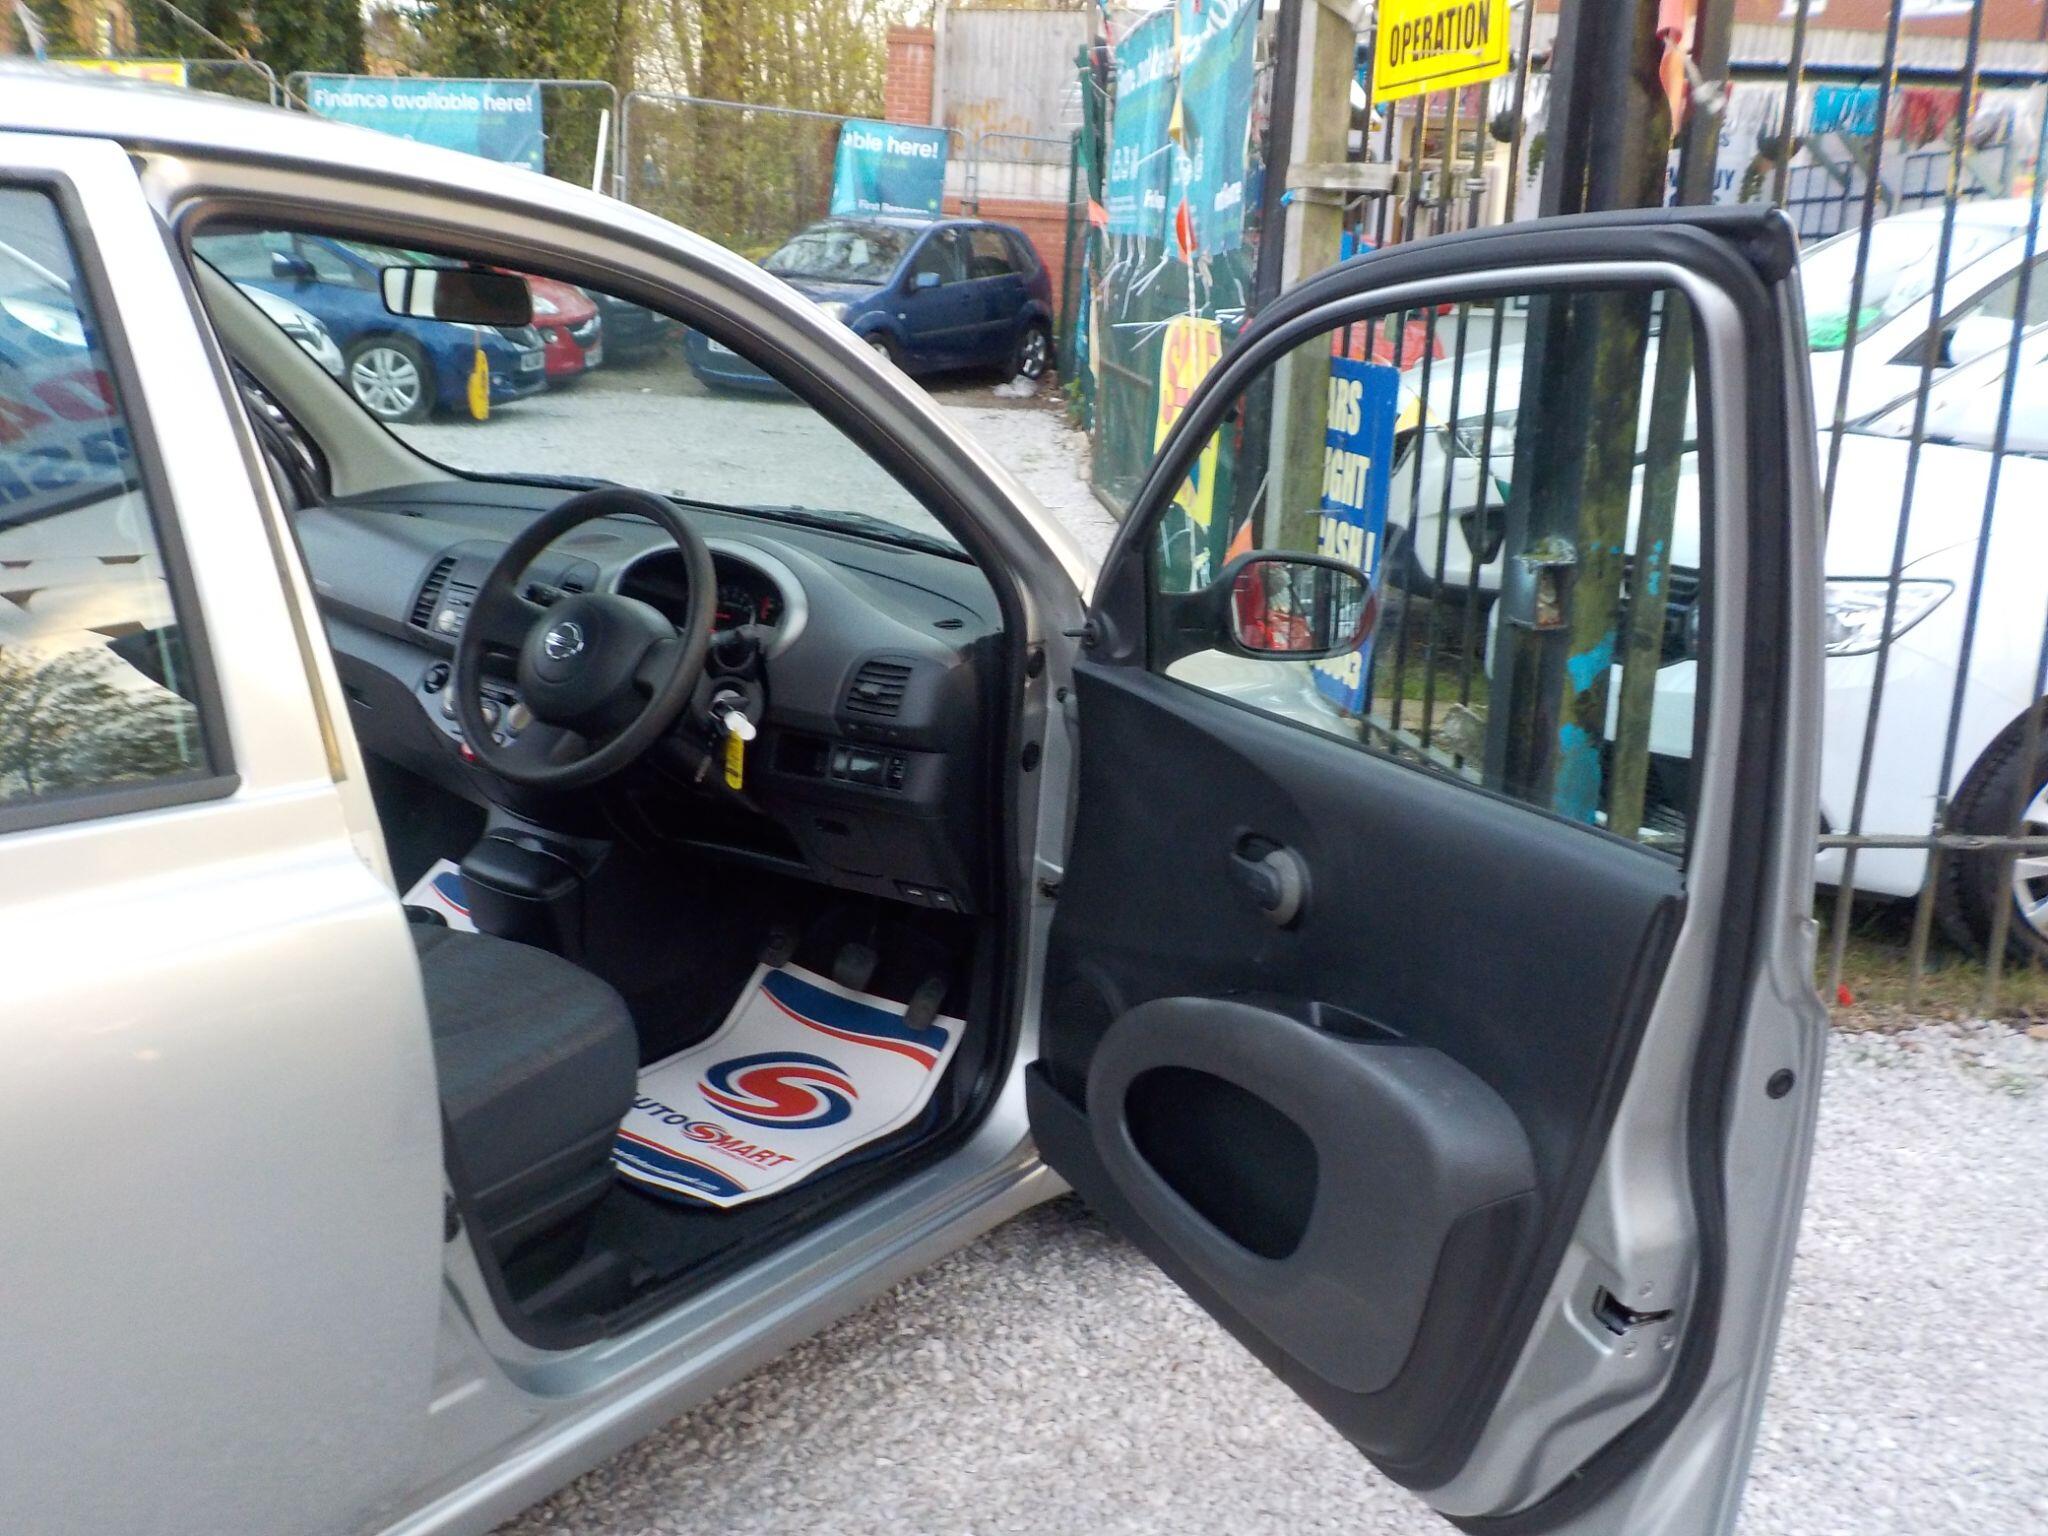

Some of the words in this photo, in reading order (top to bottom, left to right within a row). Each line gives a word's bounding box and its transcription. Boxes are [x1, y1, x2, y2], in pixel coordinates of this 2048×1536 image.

[1389, 0, 1490, 67] OPERATION
[314, 90, 388, 109] Finance
[391, 91, 479, 111] available
[483, 95, 532, 112] here!
[887, 135, 939, 159] here!
[1326, 376, 1363, 435] ARS
[633, 1093, 796, 1168] UTOSMART
